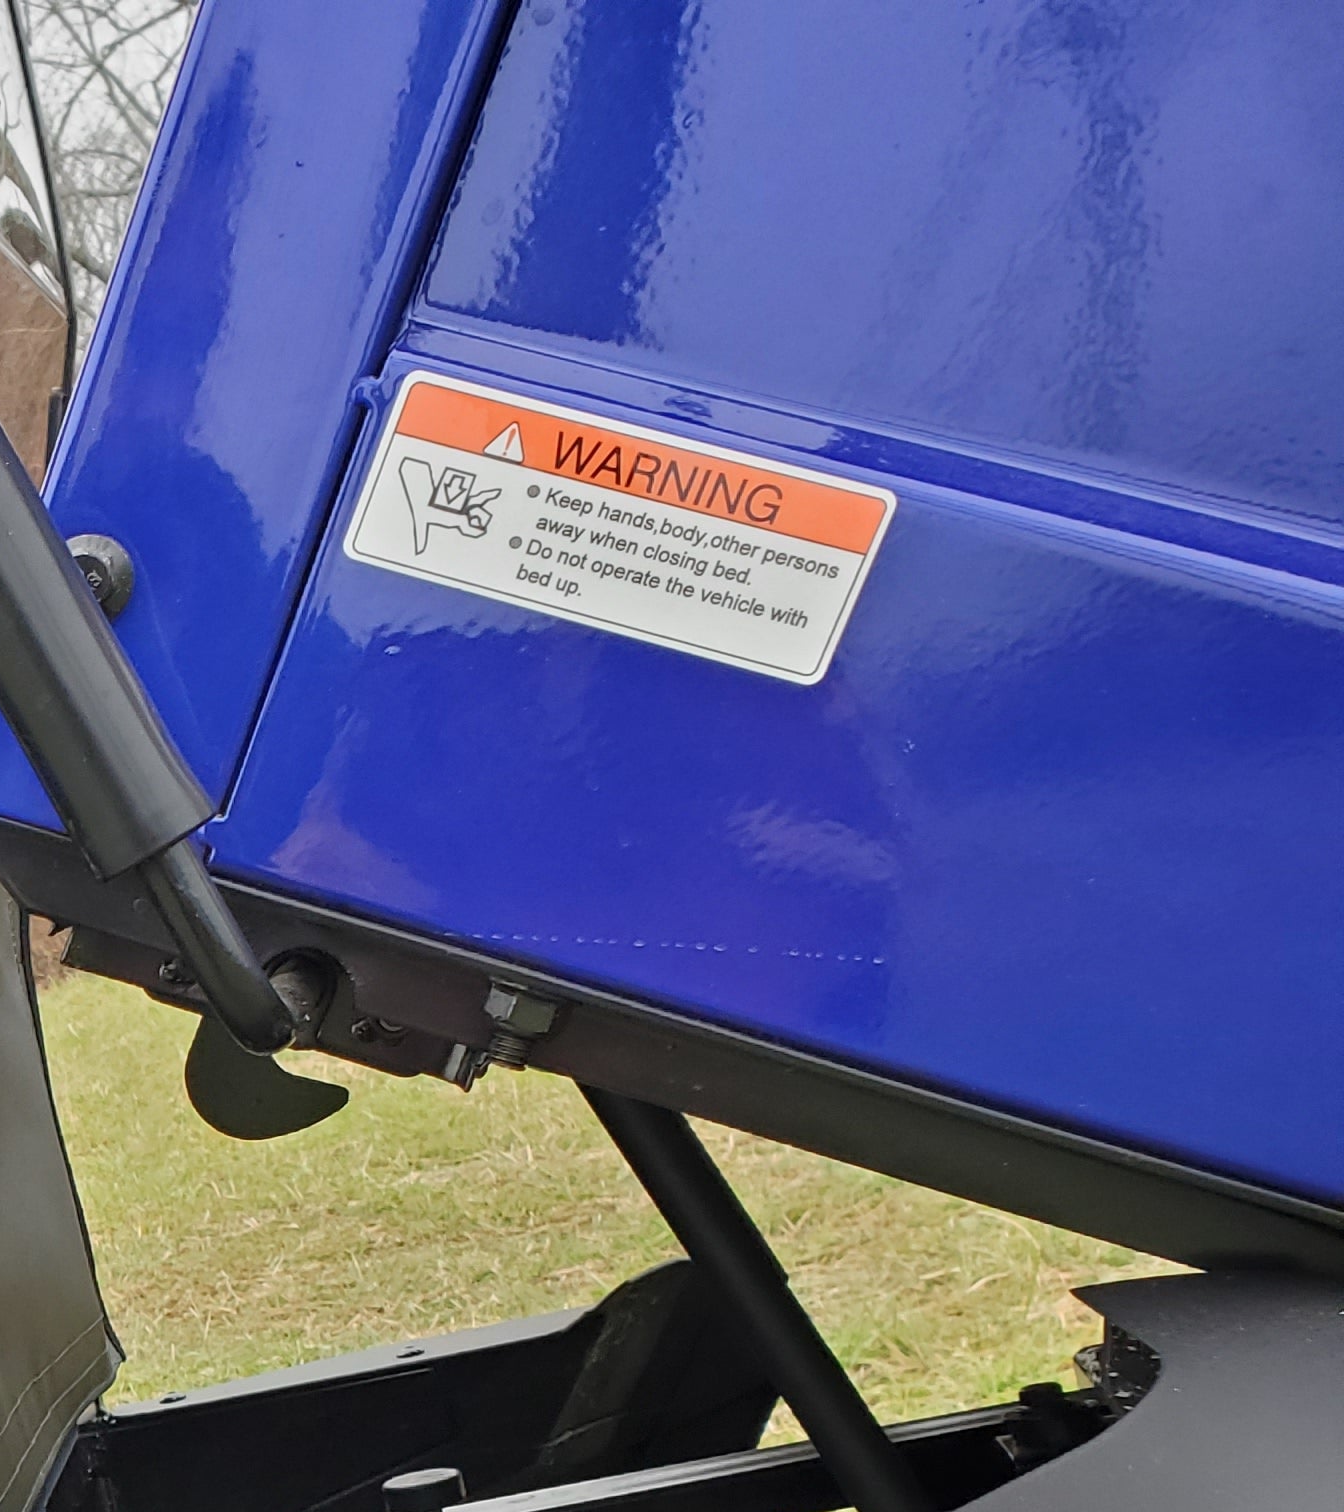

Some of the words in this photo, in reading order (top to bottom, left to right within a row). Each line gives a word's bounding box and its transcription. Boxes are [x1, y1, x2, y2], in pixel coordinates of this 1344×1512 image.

[554, 431, 783, 525] WARNING
[535, 517, 585, 543] away
[590, 531, 639, 556] when
[643, 543, 708, 577] closing
[712, 560, 751, 586] bed.
[544, 488, 594, 517] Keep
[761, 548, 840, 579] persons
[515, 563, 553, 588] bed
[555, 577, 582, 597] up.
[526, 538, 553, 560] Do
[557, 550, 588, 570] not
[590, 560, 661, 589] operate
[665, 576, 695, 598] the
[700, 587, 765, 617] vehicle
[770, 606, 809, 629] with
